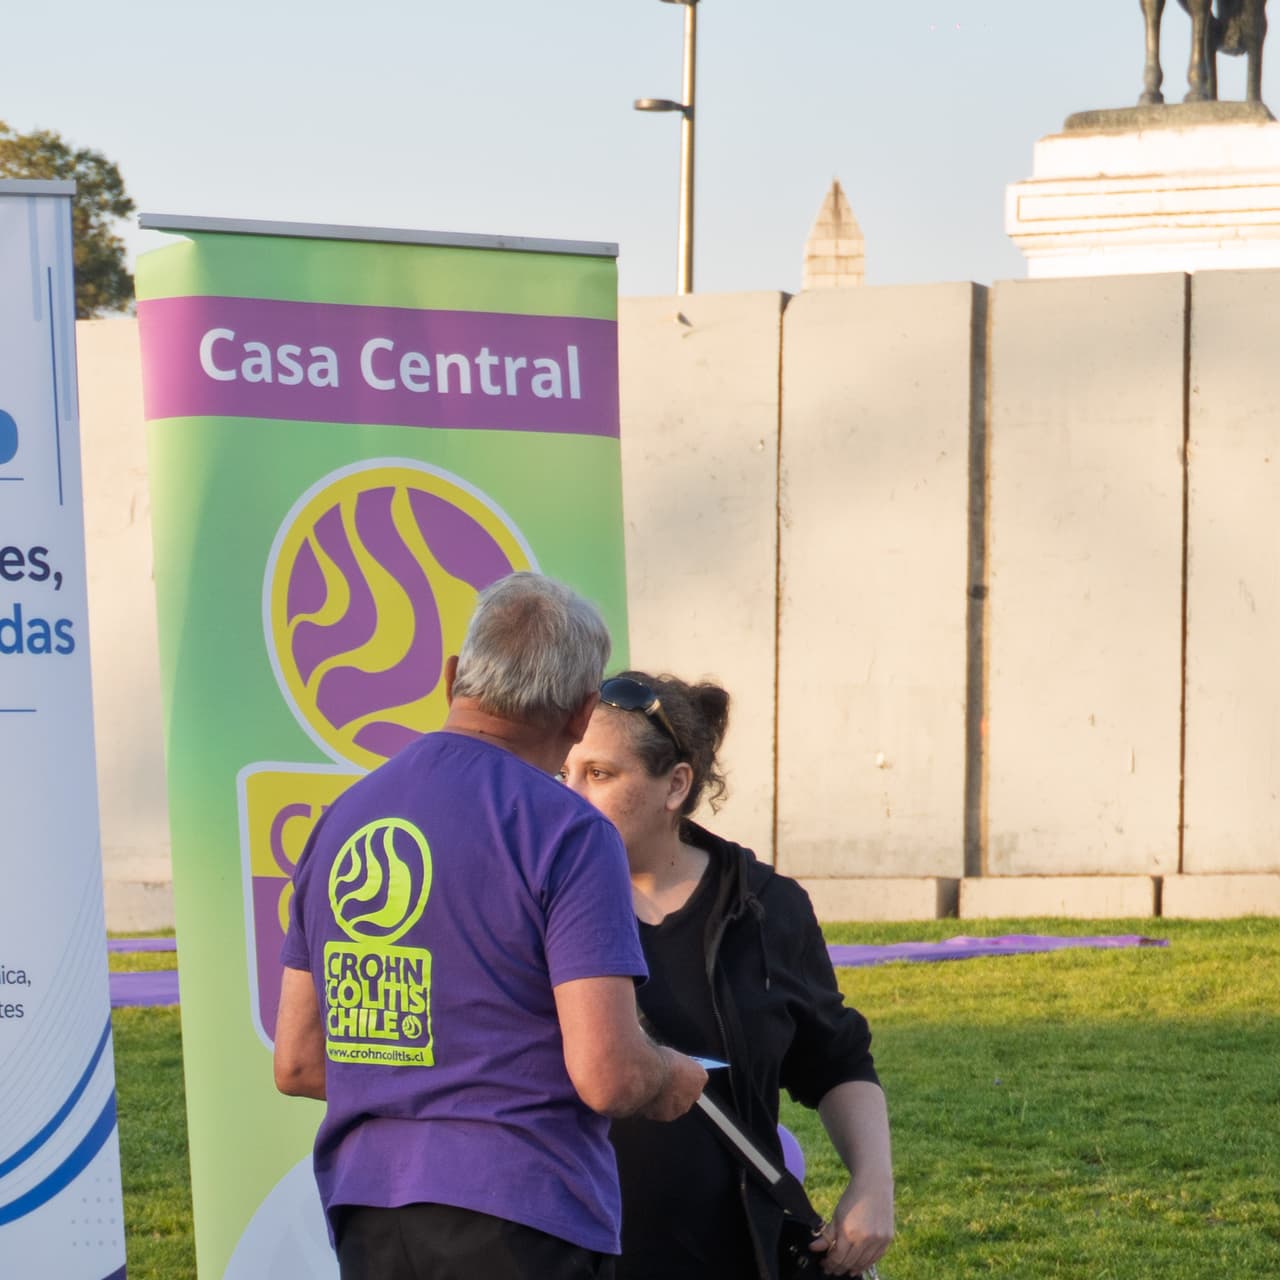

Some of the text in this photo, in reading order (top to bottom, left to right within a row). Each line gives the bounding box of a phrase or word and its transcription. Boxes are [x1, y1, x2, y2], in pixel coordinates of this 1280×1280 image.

[199, 327, 582, 400] Casa Central
[329, 951, 424, 987] CROHN
[327, 979, 426, 1014] COLITIS
[327, 1007, 400, 1041] CHILE
